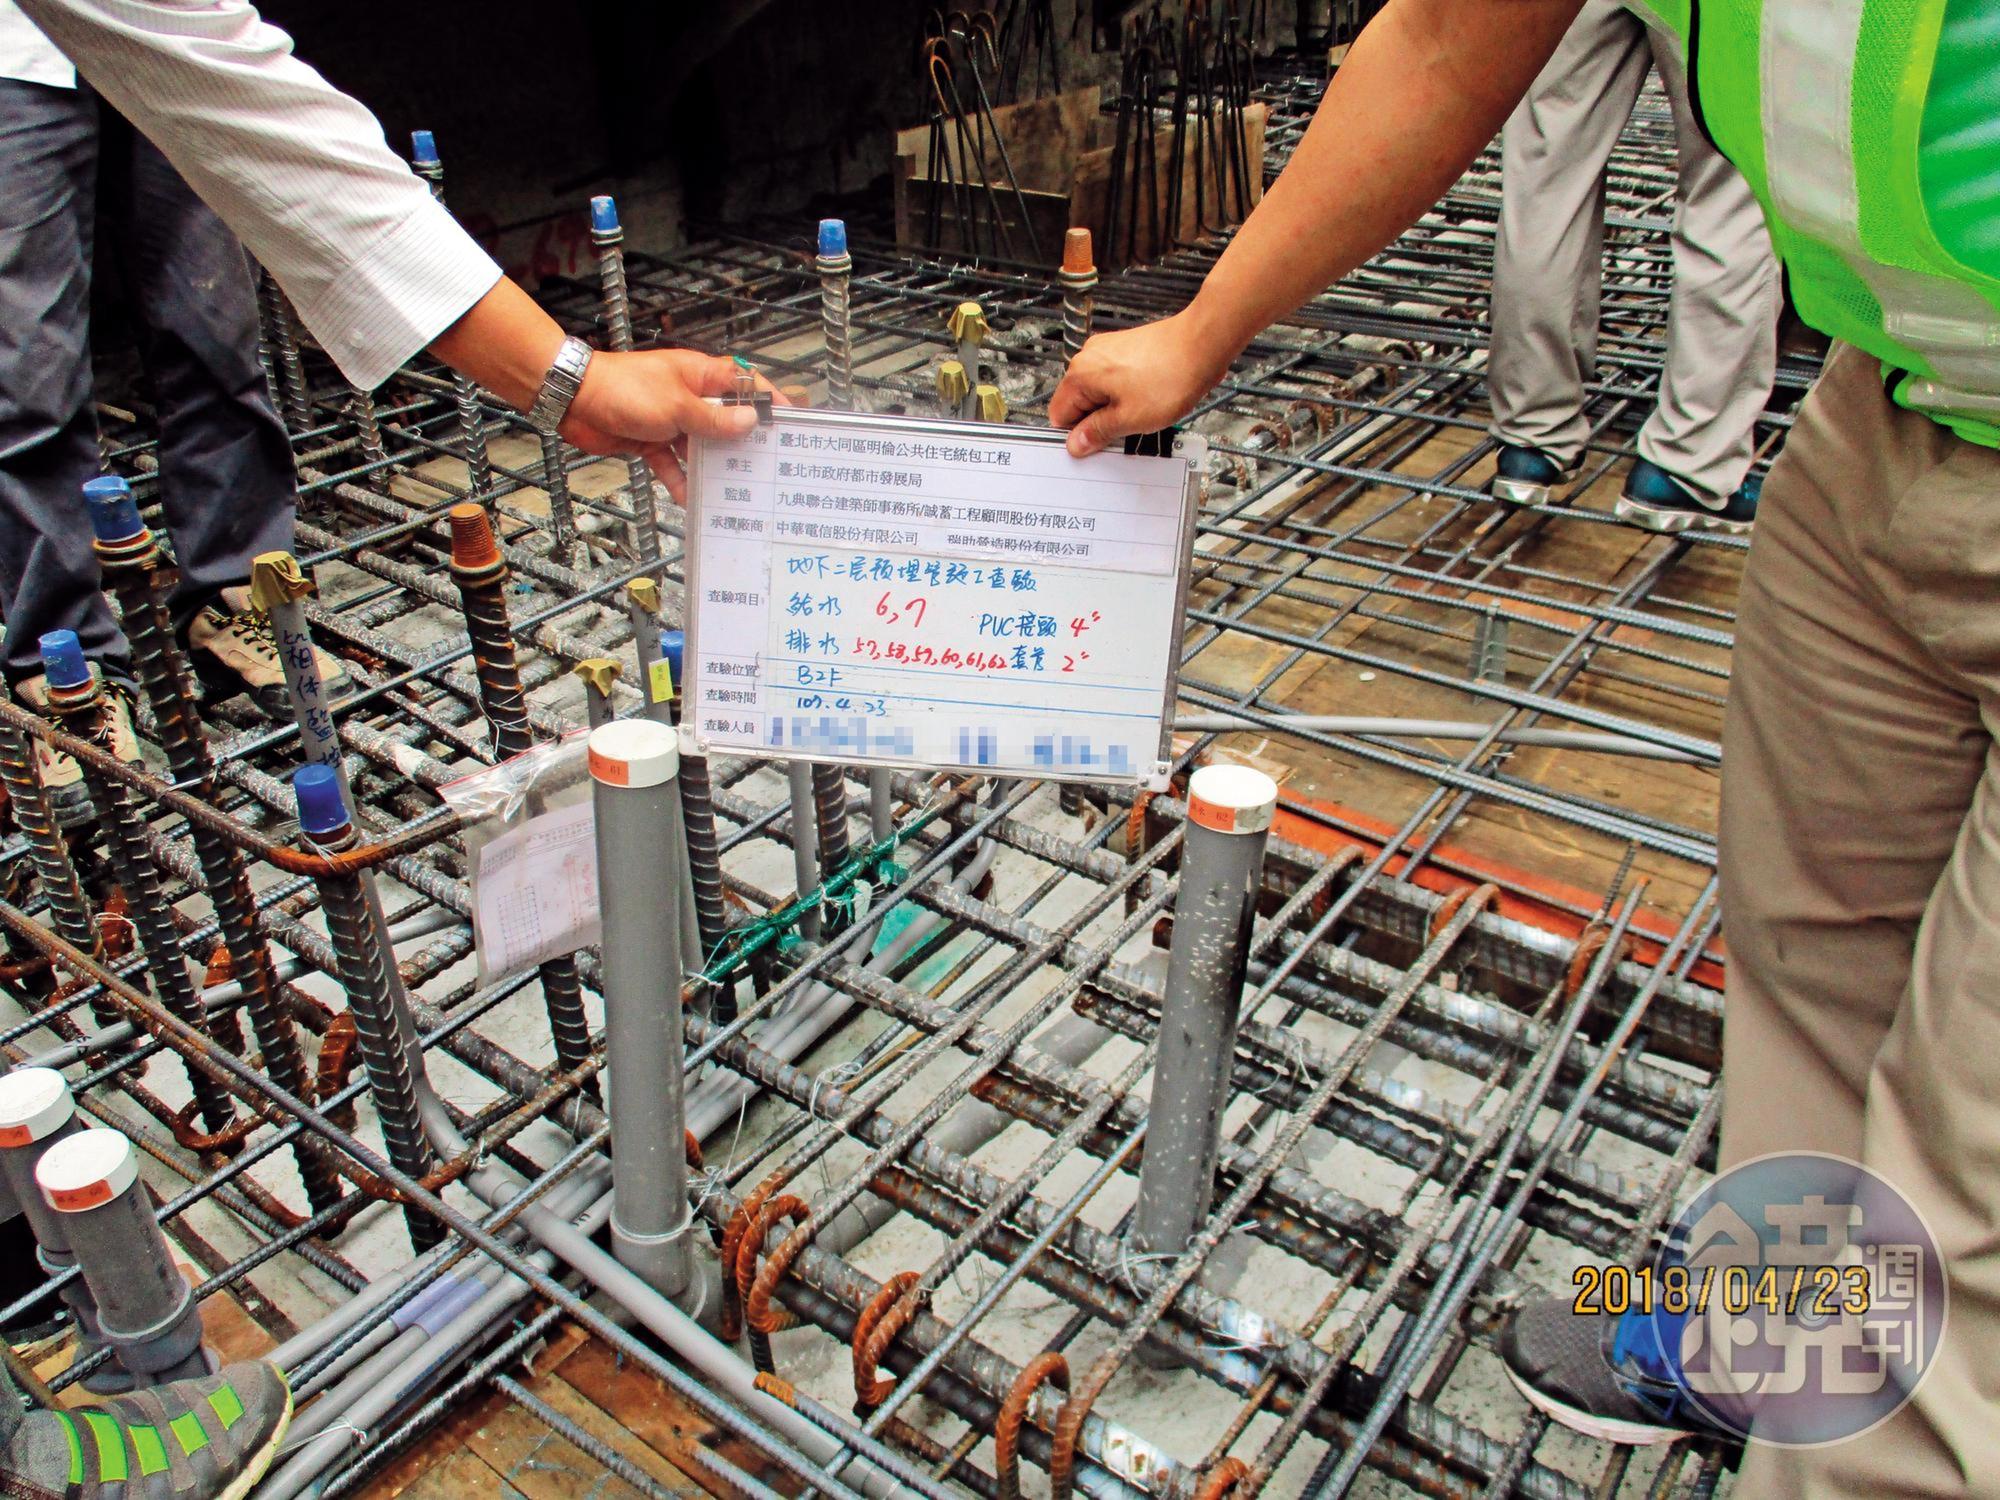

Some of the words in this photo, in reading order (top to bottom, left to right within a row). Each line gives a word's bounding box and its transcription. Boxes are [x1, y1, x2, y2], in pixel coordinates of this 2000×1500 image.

[779, 431, 1011, 466] 臺北市大同區明倫公共住宅統包工程
[726, 457, 752, 473] 業主
[778, 461, 923, 488] 臺北市政府都市發展局
[724, 487, 751, 502] 監造
[710, 515, 763, 533] 承攬廠商
[777, 520, 918, 546] 中華電信股份有限公司
[708, 589, 759, 606] 查驗項目
[786, 592, 842, 616] 給水
[876, 591, 927, 628] 6,7
[785, 628, 840, 655] 排水
[706, 661, 759, 677] 查驗位置
[797, 665, 843, 687] B2F
[705, 689, 757, 705] 查驗時間
[704, 719, 755, 735] 查驗人員
